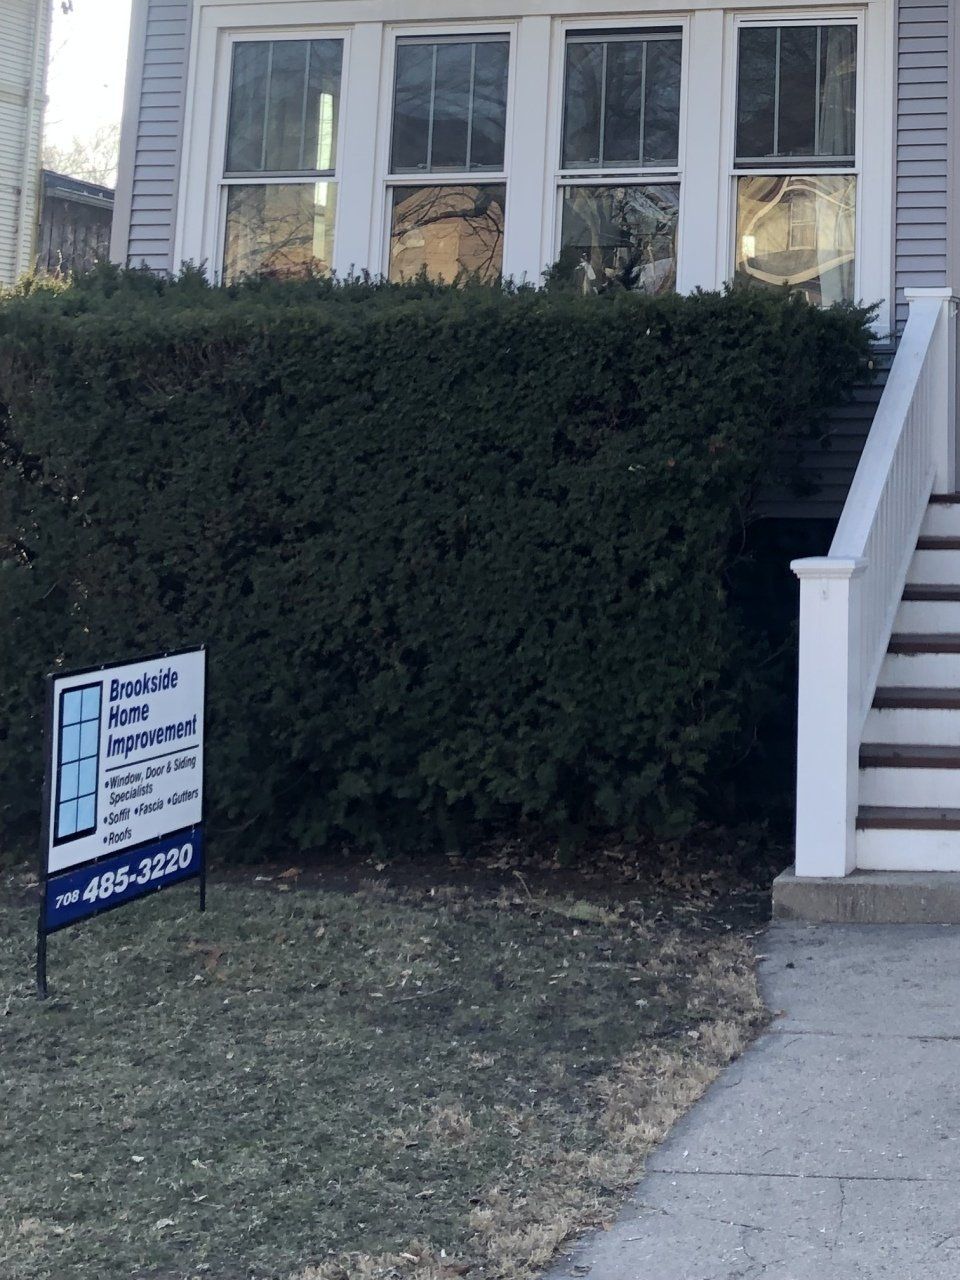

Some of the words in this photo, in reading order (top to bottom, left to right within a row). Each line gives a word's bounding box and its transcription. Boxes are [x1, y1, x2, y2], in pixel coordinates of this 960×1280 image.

[109, 667, 178, 703] Brookside
[108, 703, 150, 730] Home
[107, 714, 197, 760] Improvement
[109, 770, 144, 790] Window,
[145, 764, 165, 781] Door
[166, 760, 172, 773] &
[173, 755, 196, 774] Siding
[108, 808, 131, 826] Soffit
[139, 798, 164, 817] Fascia
[171, 788, 199, 807] Gutters
[109, 784, 153, 808] Specialists
[108, 827, 132, 846] Roofs
[55, 889, 79, 909] 708
[82, 843, 194, 904] 485-3220
